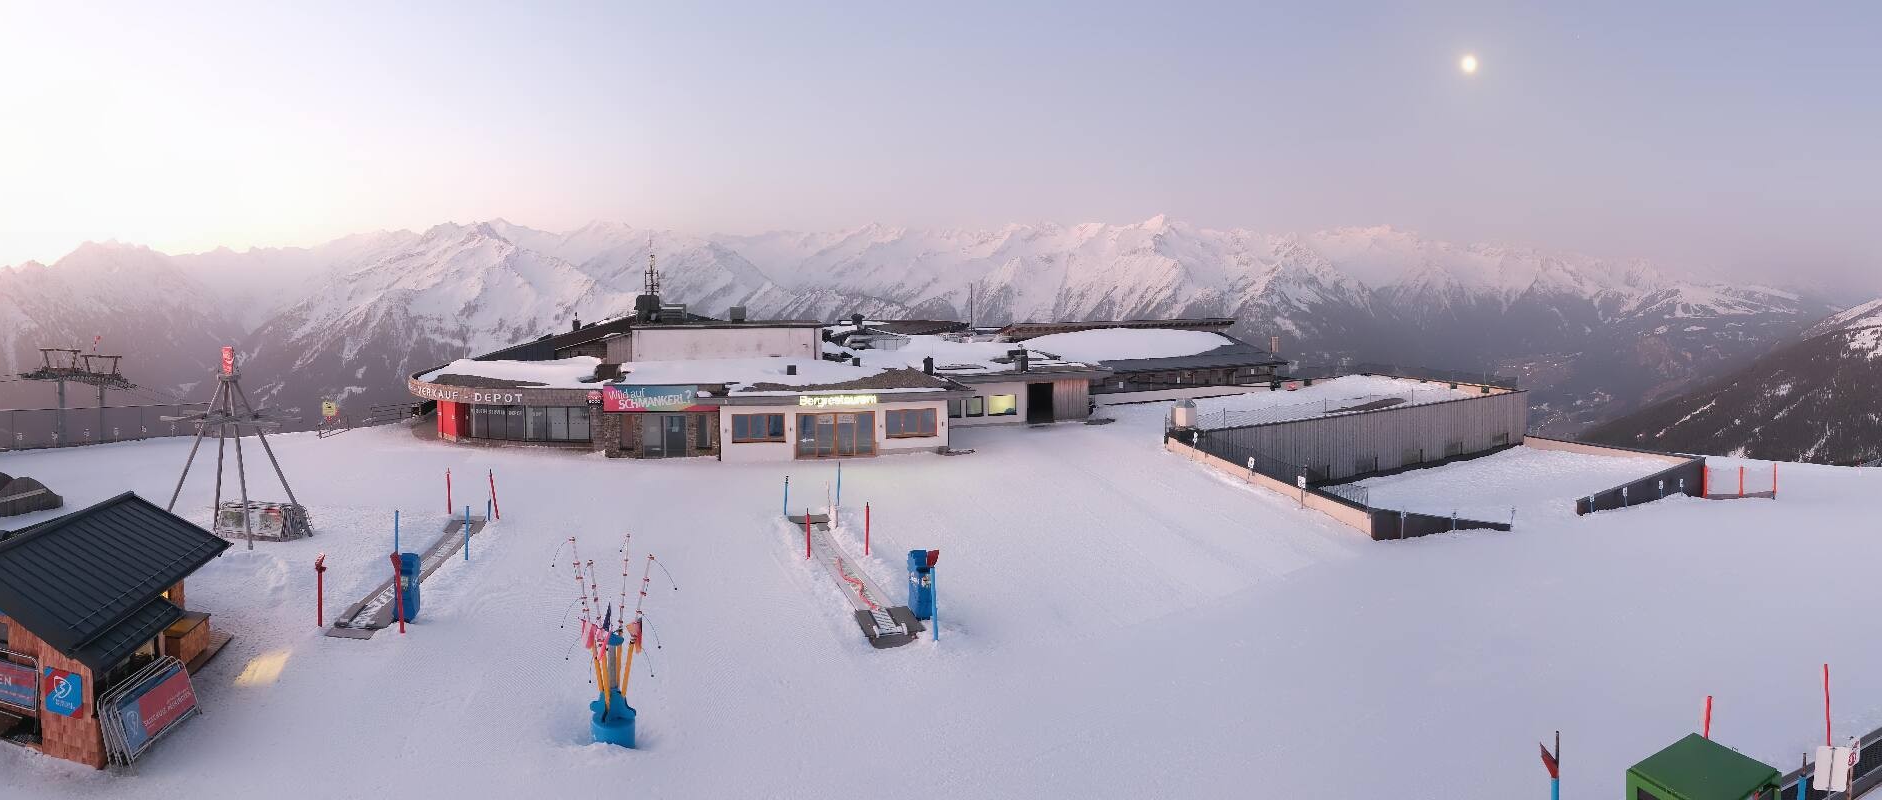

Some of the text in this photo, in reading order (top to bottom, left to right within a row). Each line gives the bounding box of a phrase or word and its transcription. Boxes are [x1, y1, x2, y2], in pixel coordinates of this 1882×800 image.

[474, 392, 523, 403] DEPOT
[608, 389, 629, 400] Wild
[630, 387, 646, 399] auf
[618, 389, 692, 410] SCHMANKERL?
[799, 394, 877, 408] Bergrestaurant
